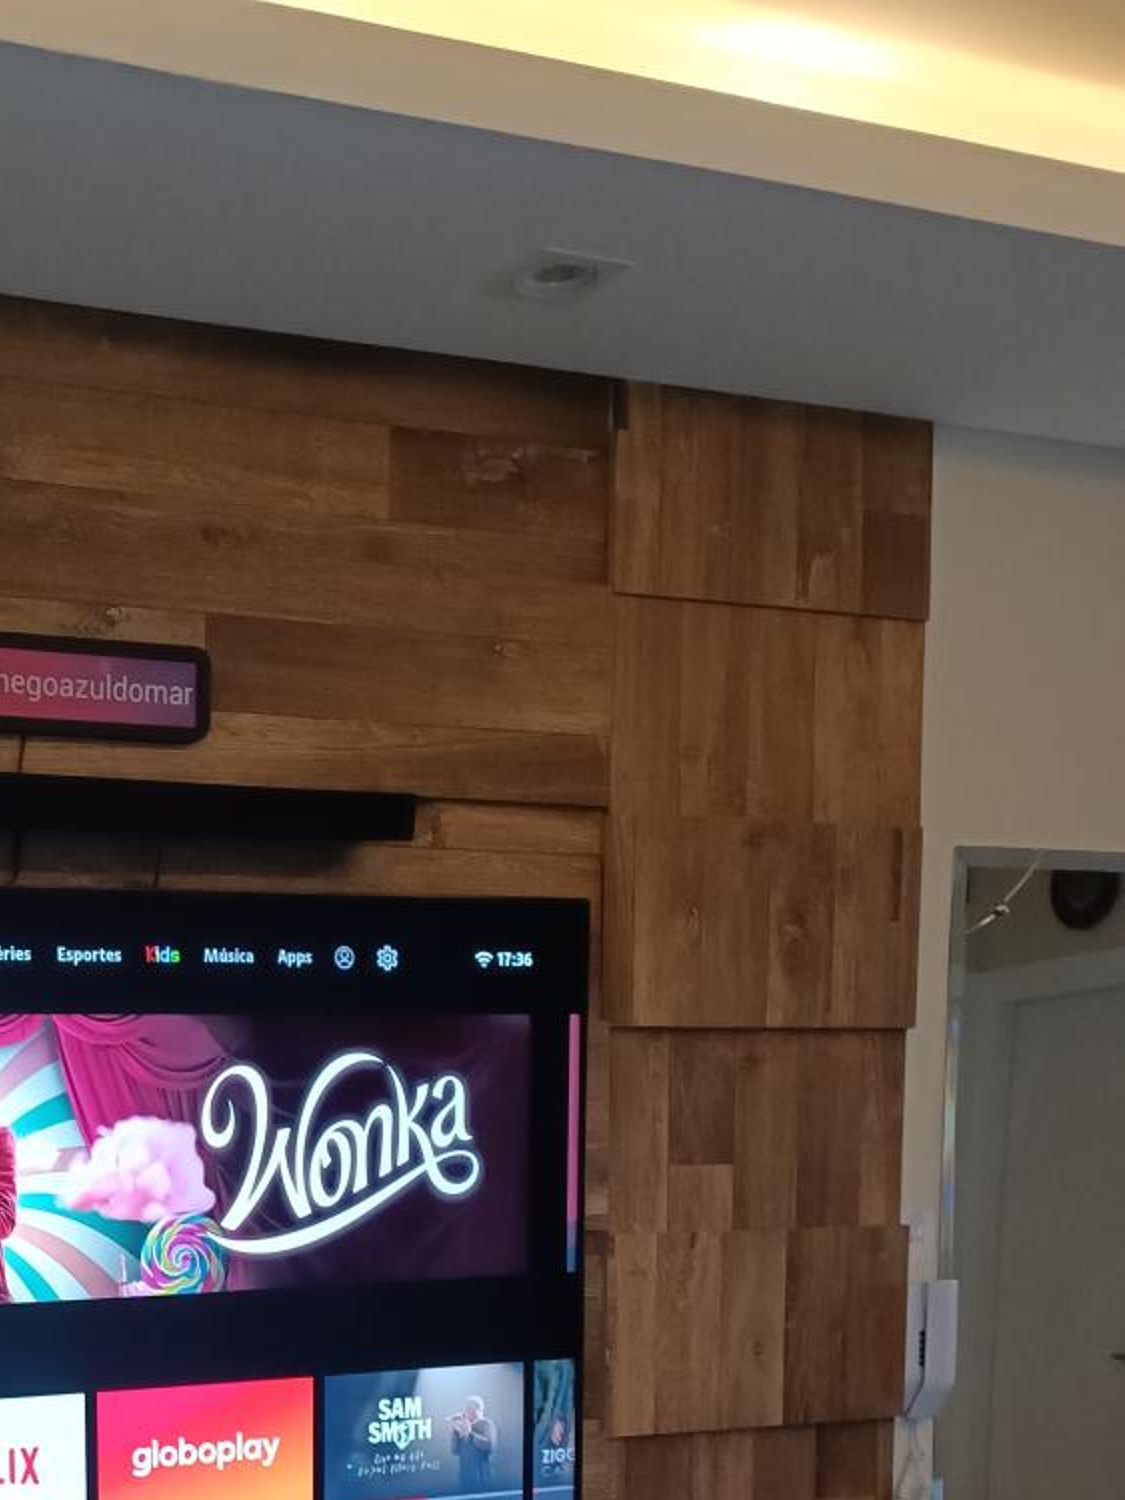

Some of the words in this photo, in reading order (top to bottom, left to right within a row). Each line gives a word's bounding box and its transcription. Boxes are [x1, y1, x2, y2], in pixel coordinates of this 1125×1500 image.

[56, 946, 123, 967] Esportes
[145, 945, 181, 964] Kids
[203, 946, 255, 964] Música
[277, 948, 313, 969] Apps
[496, 951, 534, 968] 17:36
[201, 1052, 480, 1254] Wonka
[378, 1396, 423, 1420] SAM
[131, 1430, 281, 1478] globoplay
